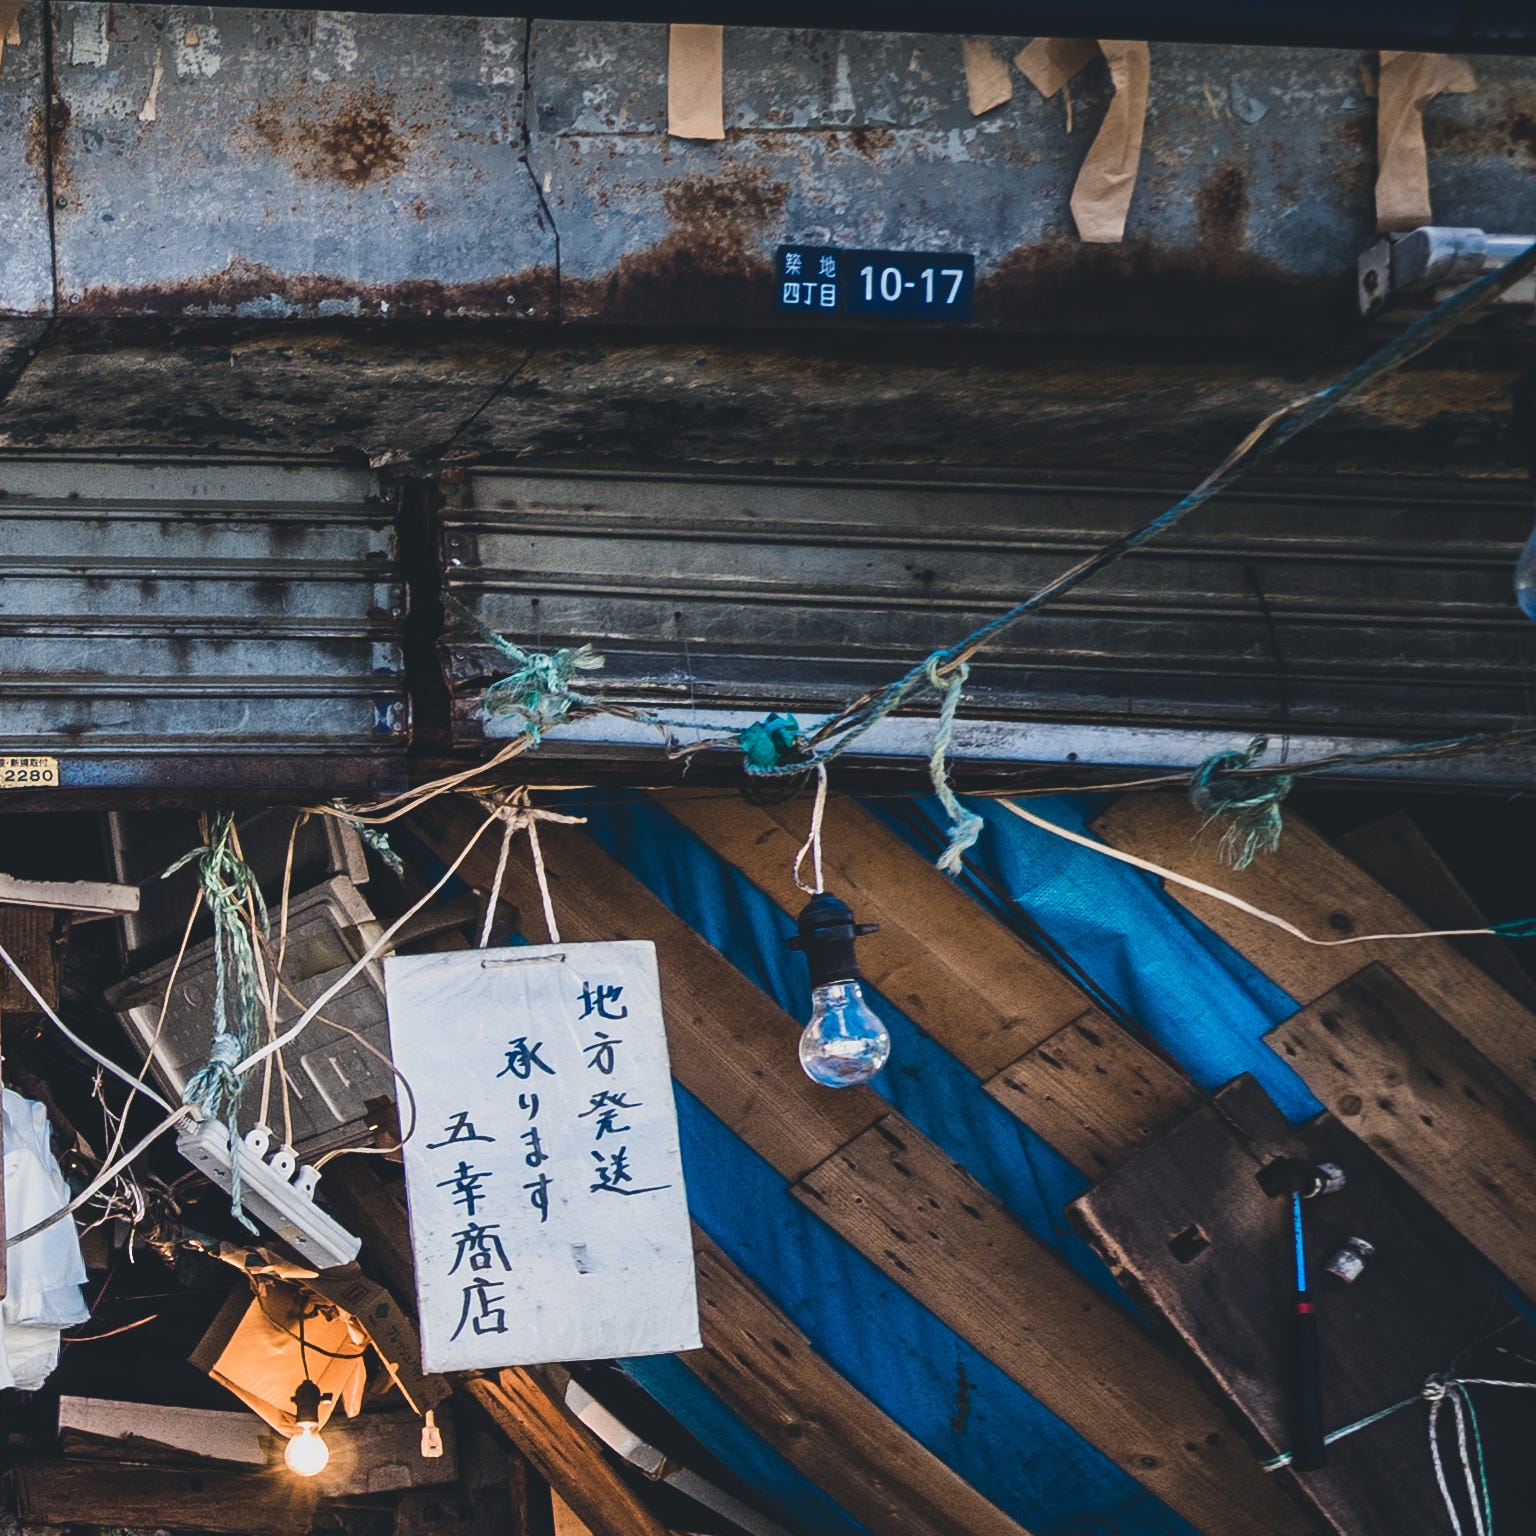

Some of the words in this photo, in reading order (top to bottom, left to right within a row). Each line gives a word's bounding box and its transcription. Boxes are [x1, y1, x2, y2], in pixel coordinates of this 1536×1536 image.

[783, 282, 837, 308] 四丁目
[785, 253, 837, 278] 築地
[859, 265, 964, 304] 10-17
[496, 1036, 556, 1223] 承ります
[576, 981, 672, 1196] 地方発送
[426, 1110, 513, 1342] 五幸商店
